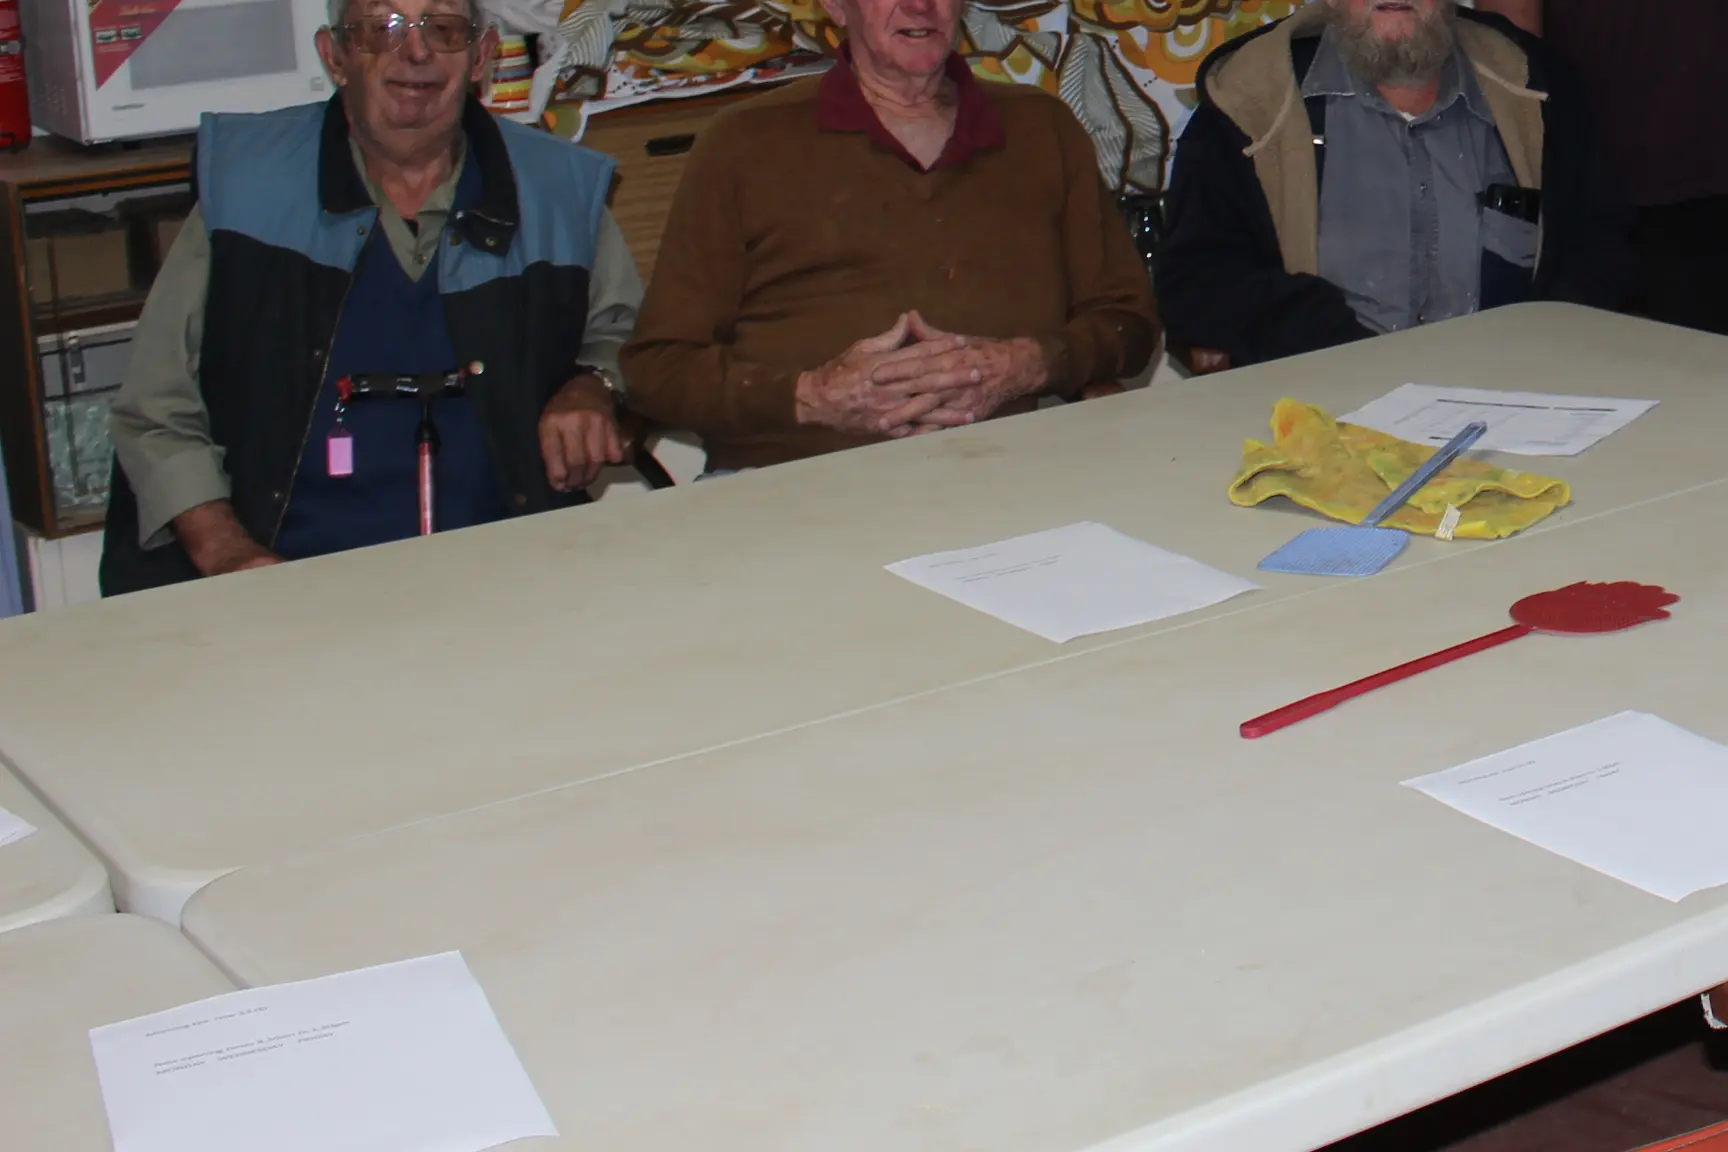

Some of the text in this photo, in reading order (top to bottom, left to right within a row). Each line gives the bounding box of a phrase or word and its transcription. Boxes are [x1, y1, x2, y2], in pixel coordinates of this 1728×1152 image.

[155, 1031, 336, 1076] MONDAY WEDNESDAY FRIDAY
